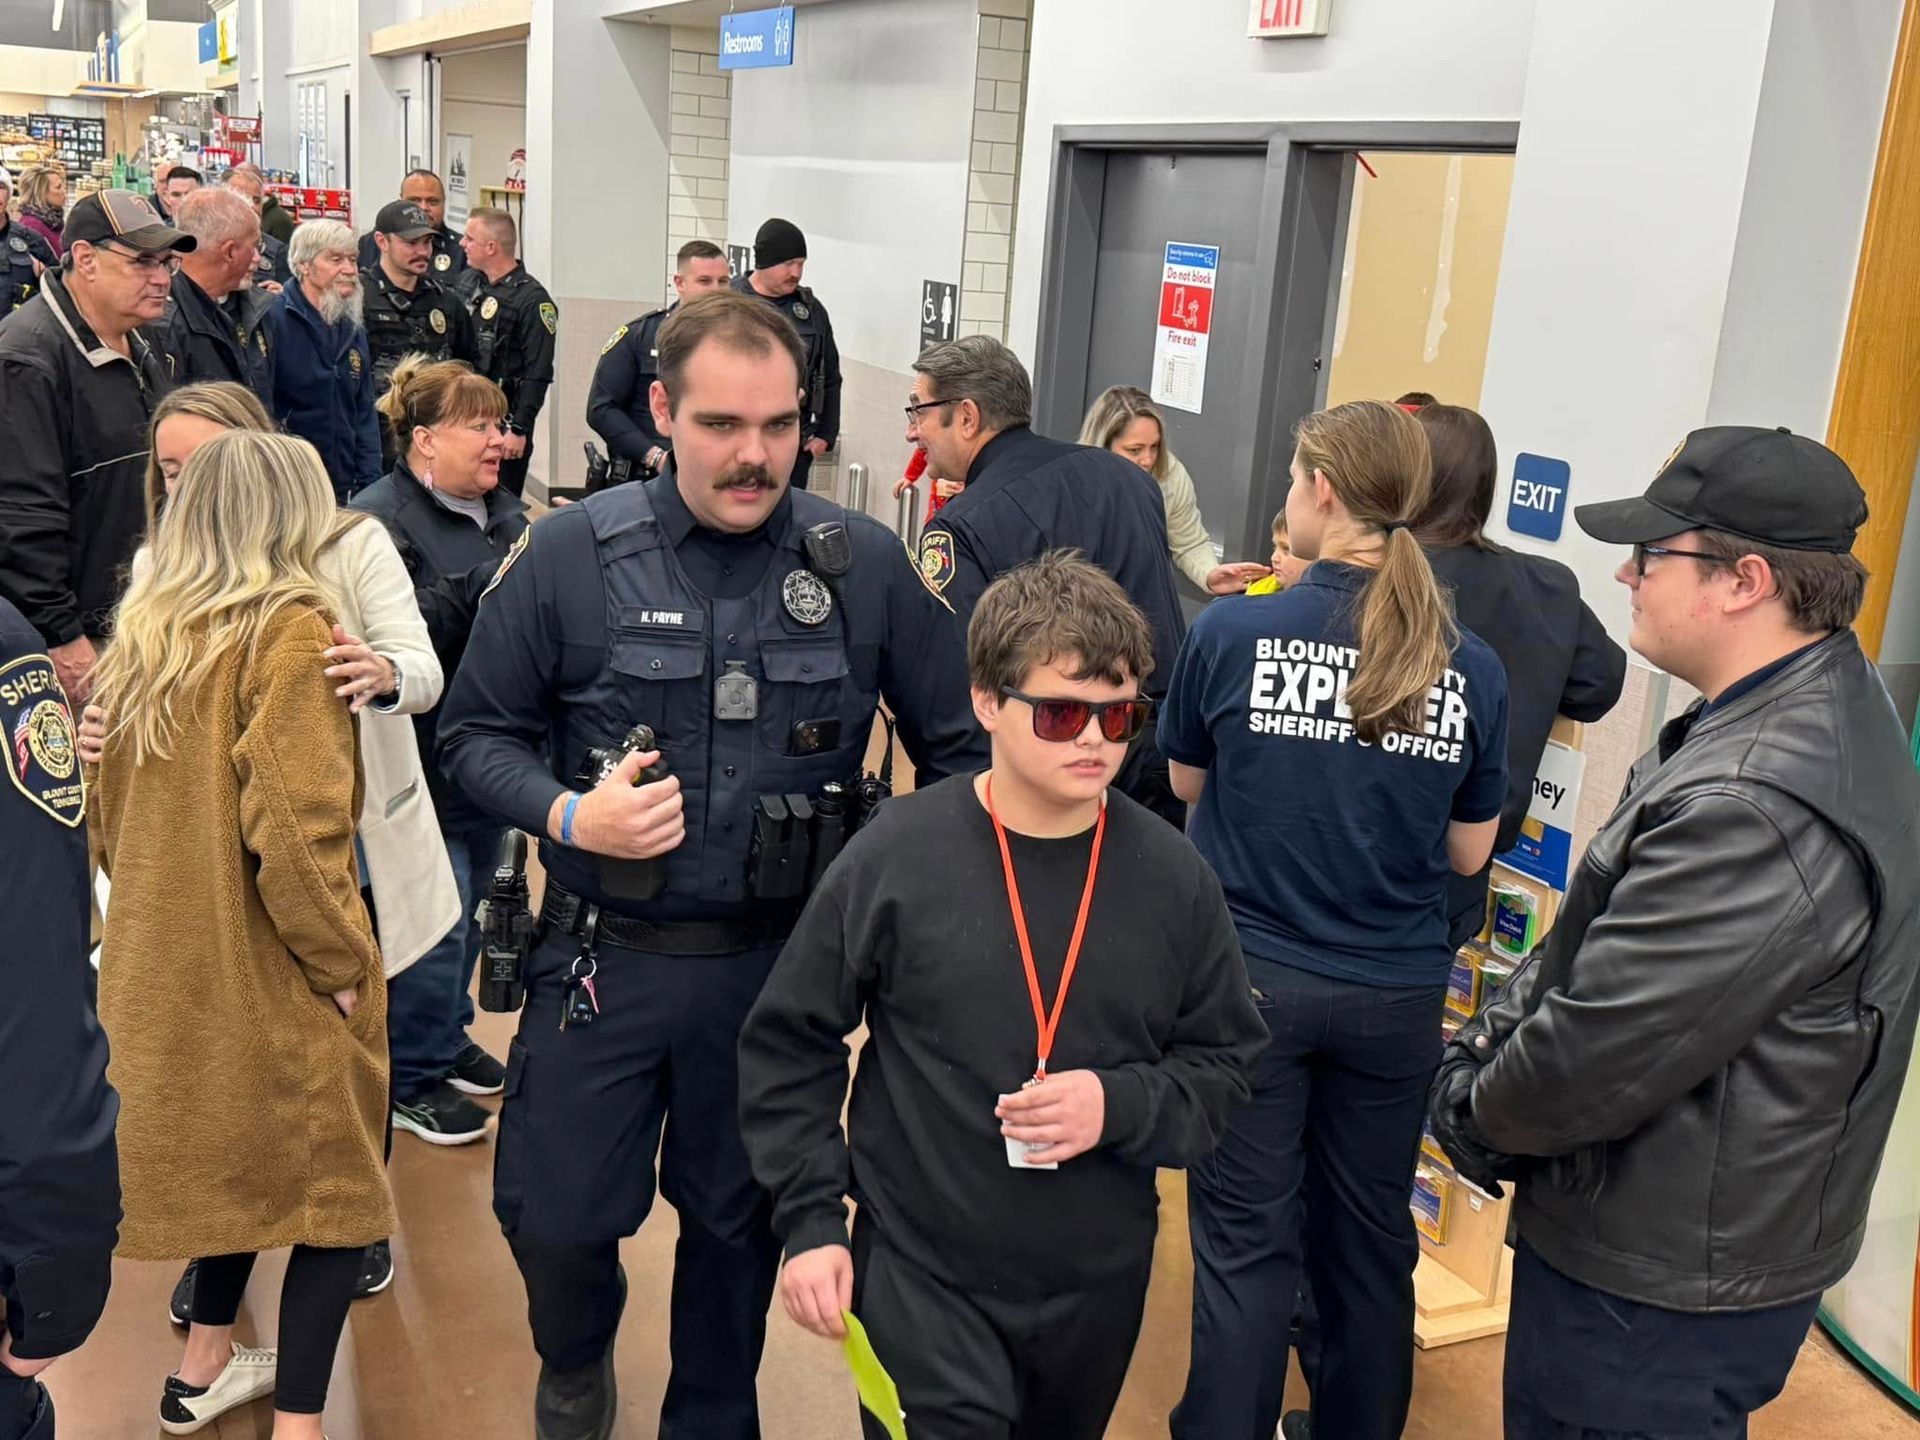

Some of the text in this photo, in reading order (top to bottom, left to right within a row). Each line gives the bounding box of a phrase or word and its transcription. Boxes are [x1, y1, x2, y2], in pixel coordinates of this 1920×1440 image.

[724, 31, 763, 54] Restrooms
[1167, 267, 1212, 284] Do not block
[1168, 330, 1196, 347] Fire exit
[1512, 479, 1562, 513] EXIT
[652, 611, 684, 625] PAYNE
[1255, 638, 1360, 669] BLOUNT
[1250, 661, 1469, 740] EXPLER
[1249, 711, 1463, 763] SHERIFF' OFFICE
